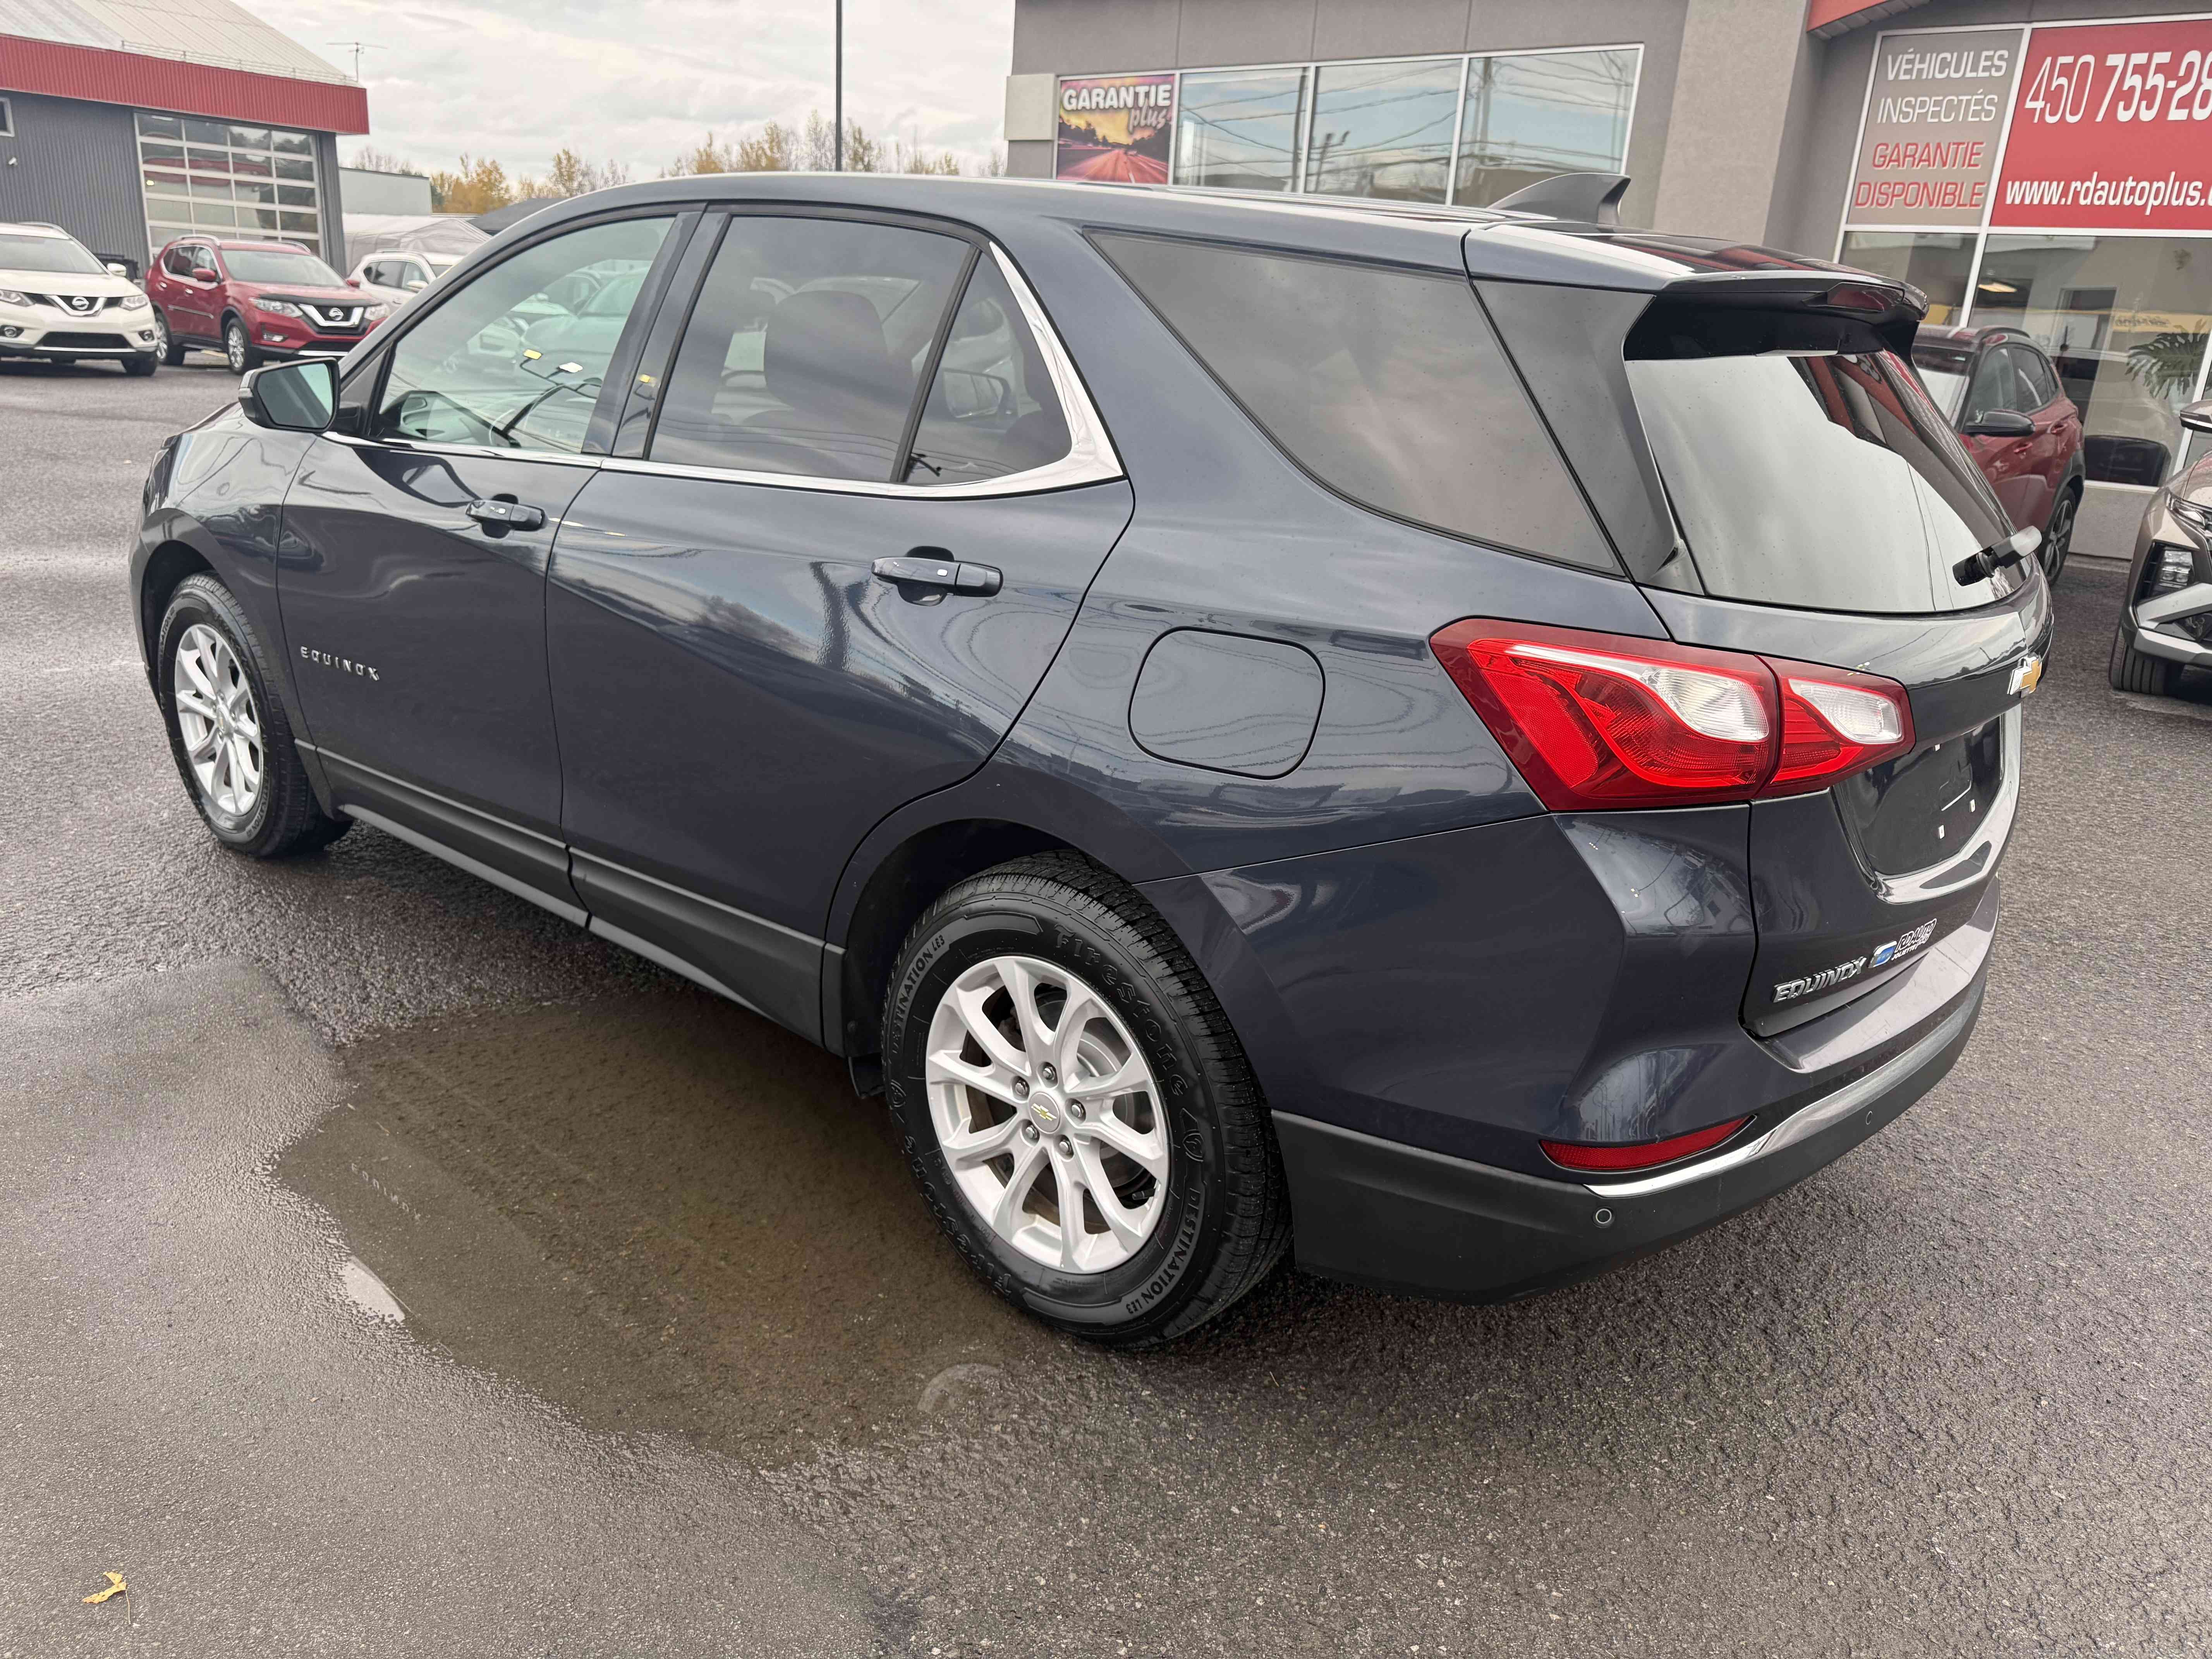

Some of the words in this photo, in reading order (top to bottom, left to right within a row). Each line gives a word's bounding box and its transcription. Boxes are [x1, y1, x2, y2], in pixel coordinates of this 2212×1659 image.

[1887, 48, 2009, 80] VÉHICULES
[1063, 84, 1171, 110] GARANTIE
[2025, 55, 2095, 124] 450
[2095, 51, 2212, 122] 755-28
[1129, 100, 1166, 132] plus
[1877, 89, 1997, 123] INSPECTÉS
[1872, 141, 1985, 169] GARANTIE
[1855, 180, 1987, 209] DISPONIBLE
[301, 646, 380, 681] EQUINOX
[931, 934, 945, 951] LE3
[1773, 956, 1866, 1002] EQUINOX
[1141, 1187, 1200, 1304] DESTINATION
[1126, 1298, 1142, 1314] LE3
